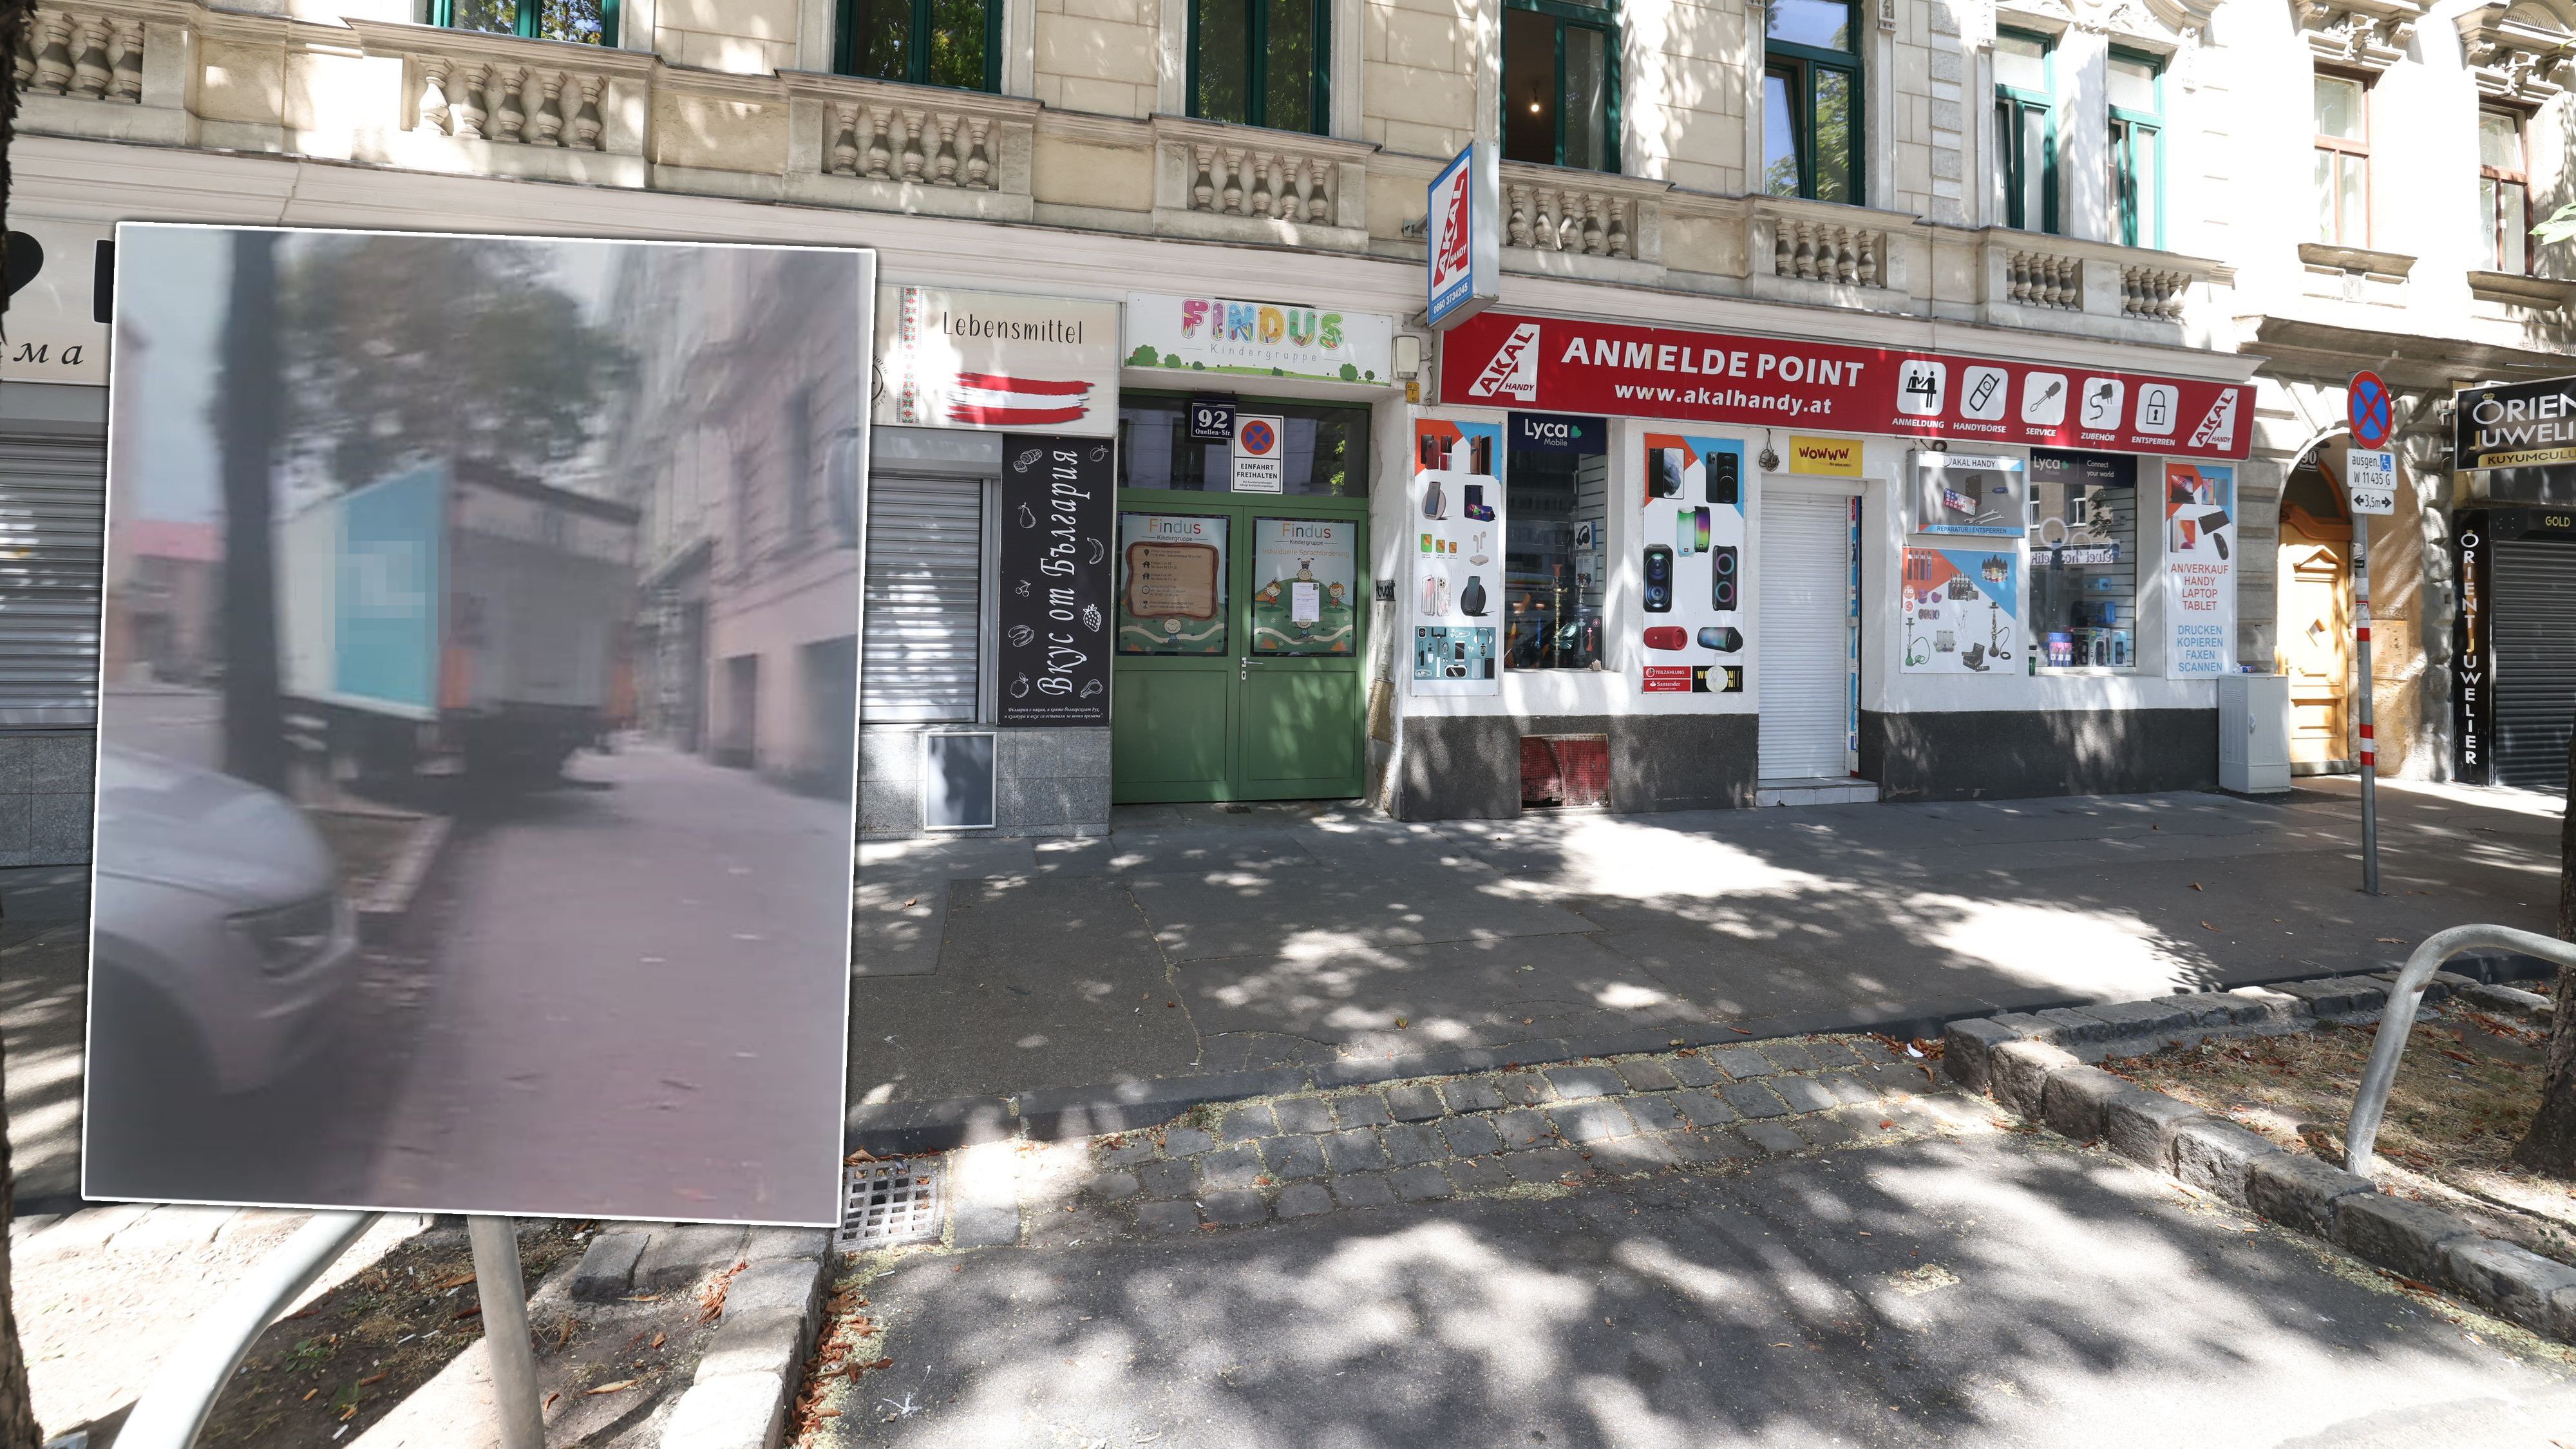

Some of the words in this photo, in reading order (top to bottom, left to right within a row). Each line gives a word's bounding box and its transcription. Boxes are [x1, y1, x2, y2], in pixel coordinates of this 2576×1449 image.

[1438, 178, 1464, 276] AKAL
[1450, 243, 1467, 265] HANDY
[1433, 299, 1446, 314] 0660
[1446, 282, 1468, 305] 3734245
[943, 311, 1083, 345] Lebensmittel
[1181, 298, 1344, 350] FINDUS
[1210, 343, 1317, 363] Kindergruppe
[1479, 332, 1535, 395] AKAL
[1561, 337, 1749, 378] ANMELDE
[1756, 354, 1864, 387] POINT
[1615, 384, 1832, 417] www.akalhandy.at
[1198, 409, 1228, 429] 92
[1892, 418, 1944, 429] ANMELDUNG
[2195, 395, 2234, 445] AKAL
[1524, 419, 1568, 439] Lyca
[1953, 422, 2007, 433] HANDYBÖRSE
[2025, 428, 2056, 437] SERVICE
[1544, 438, 1567, 446] Mobile
[2080, 432, 2116, 442] ZUBEHÖR
[2131, 437, 2175, 446] ENTSPERREN
[2468, 421, 2574, 450] JUWELI
[1952, 458, 1971, 467] AKAL
[1972, 459, 1996, 468] HANDY
[2033, 456, 2061, 471] Lyca
[2087, 460, 2109, 469] Connect
[2352, 454, 2380, 469] ausgen.
[2354, 471, 2360, 483] W
[2385, 473, 2391, 486] G
[2364, 495, 2381, 509] 3,5m
[1040, 450, 1090, 576] България
[1149, 518, 1201, 535] Findus
[2545, 516, 2570, 527] GOLD
[1282, 523, 1331, 538] Findus
[2170, 564, 2229, 574] AN/VERKAUF
[2184, 576, 2216, 587] HANDY
[2182, 589, 2218, 598] LAPTOP
[1048, 587, 1075, 621] от
[2183, 600, 2217, 611] TABLET
[2177, 625, 2222, 635] DRUCKEN
[2177, 637, 2223, 647] KOPIEREN
[2186, 650, 2215, 659] FAXEN
[1037, 632, 1087, 696] Вкус
[2178, 661, 2222, 672] SCANNEN
[2460, 638, 2481, 765] JUWELIER
